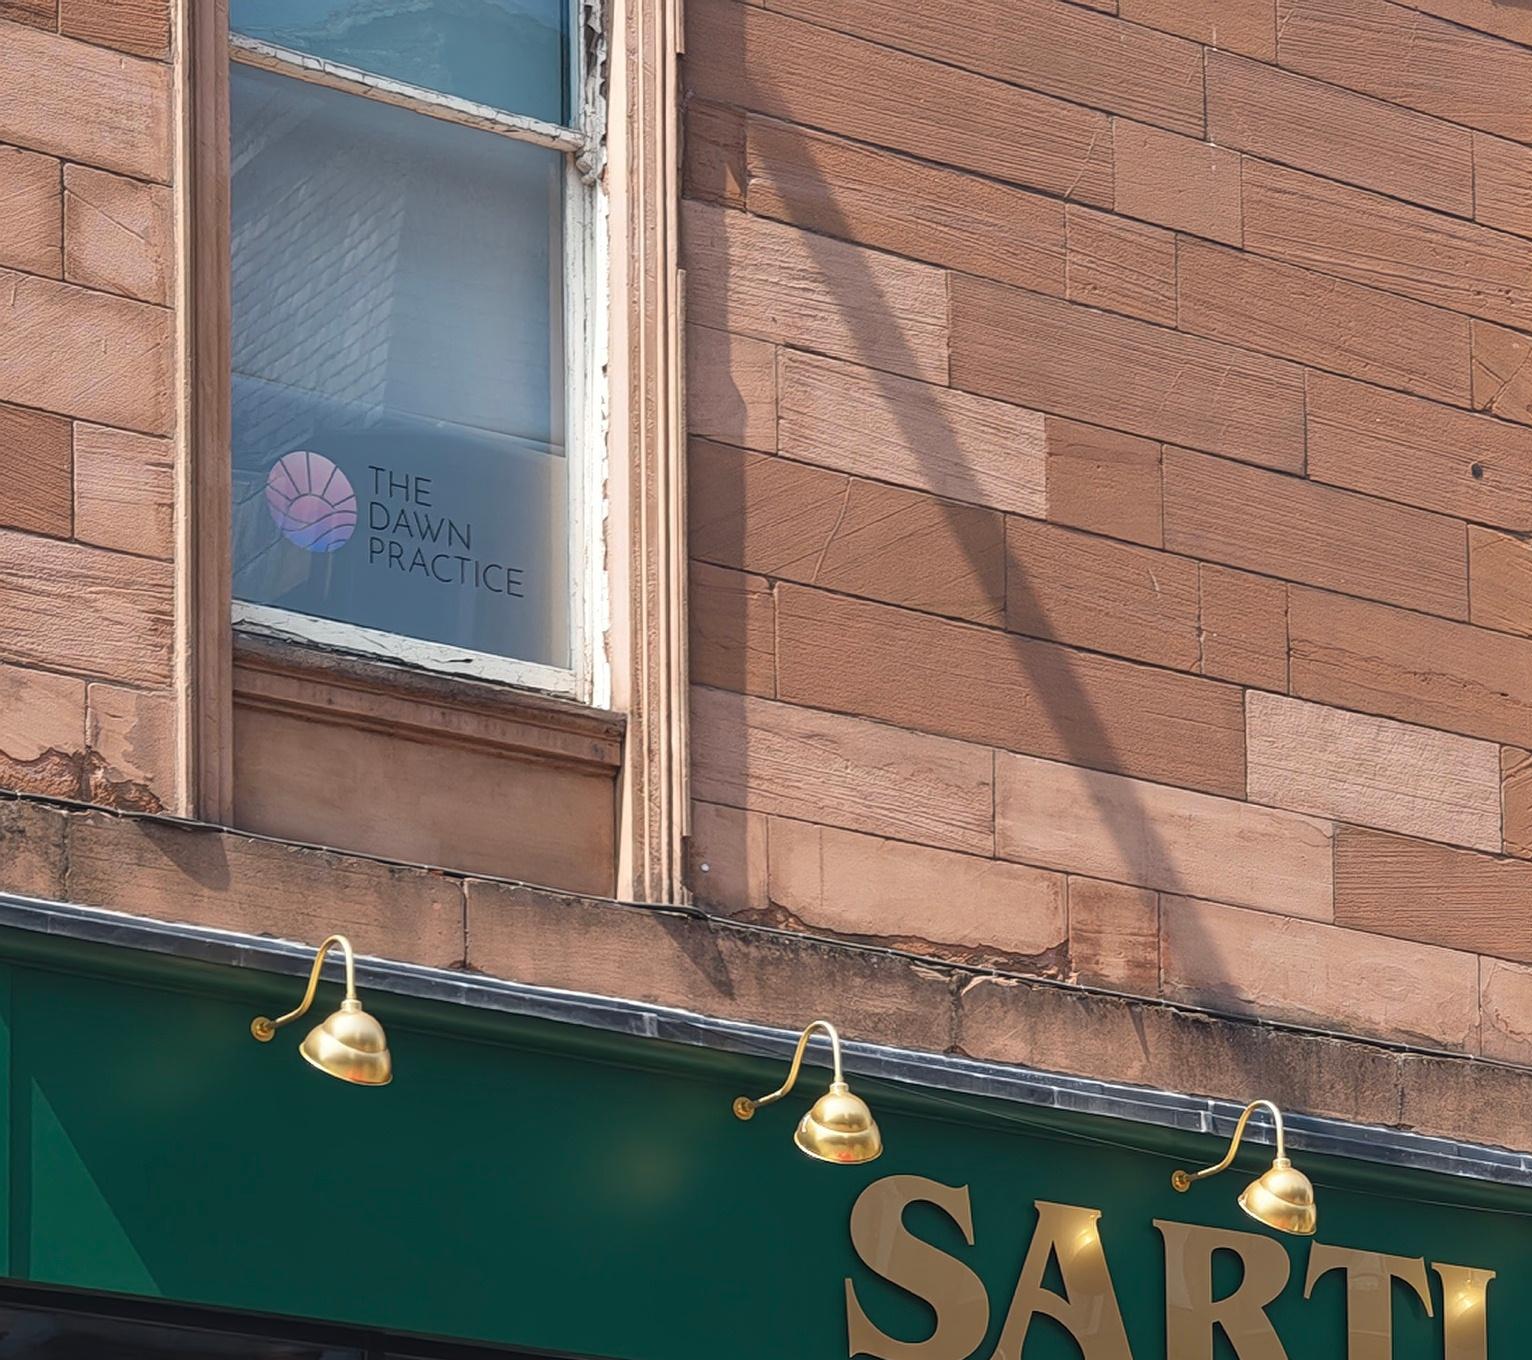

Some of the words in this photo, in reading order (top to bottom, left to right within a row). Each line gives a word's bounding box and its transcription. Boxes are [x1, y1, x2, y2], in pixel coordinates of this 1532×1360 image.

[368, 465, 432, 507] THE
[369, 502, 471, 551] DAWN
[368, 537, 525, 598] PRACTICE
